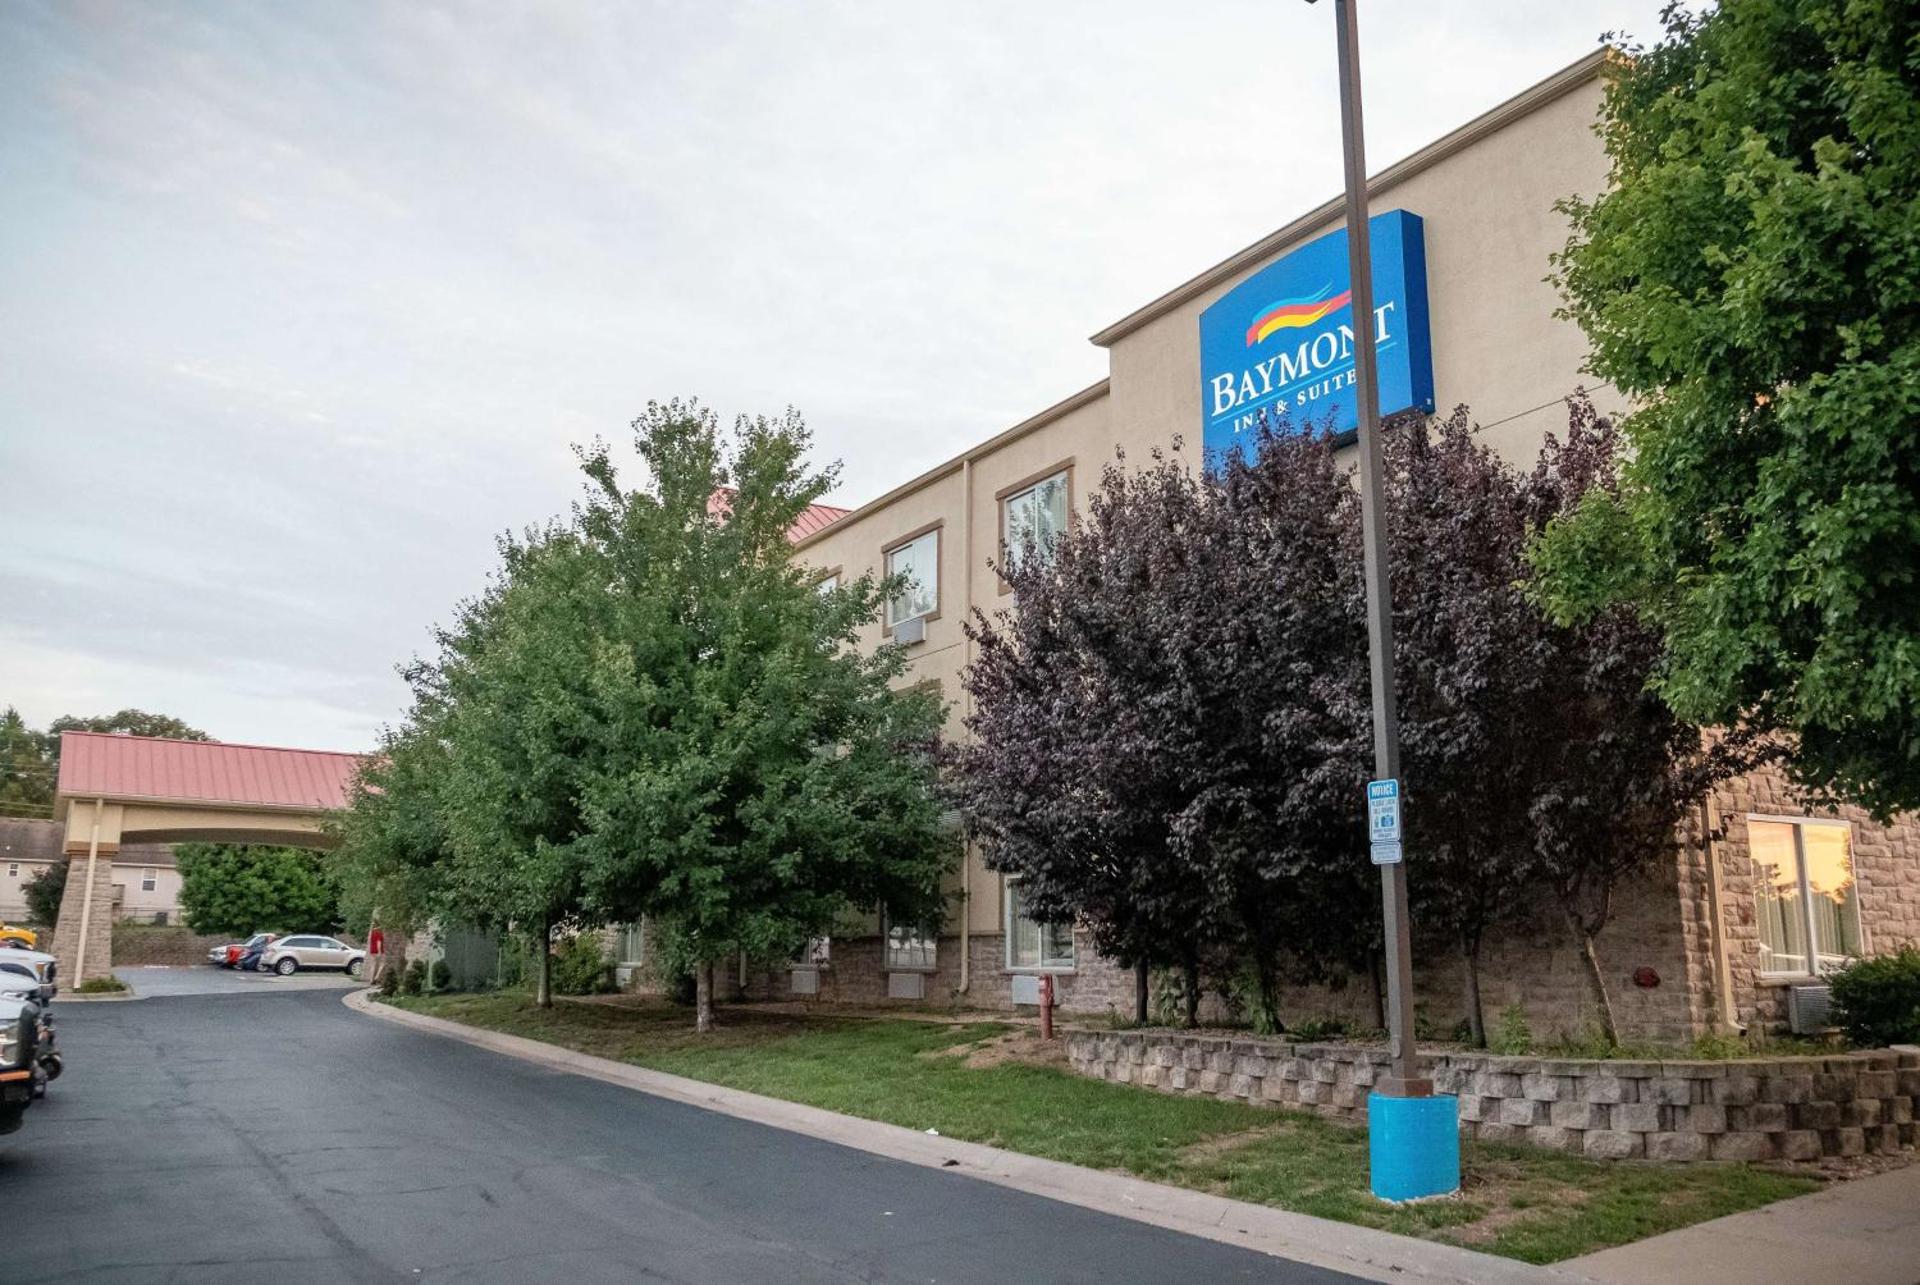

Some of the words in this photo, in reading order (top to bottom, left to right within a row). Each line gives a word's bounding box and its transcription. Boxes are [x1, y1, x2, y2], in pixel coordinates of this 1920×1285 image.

[1277, 400, 1288, 415] &
[1297, 368, 1357, 406] SUITE
[1371, 784, 1394, 797] NOTICE
